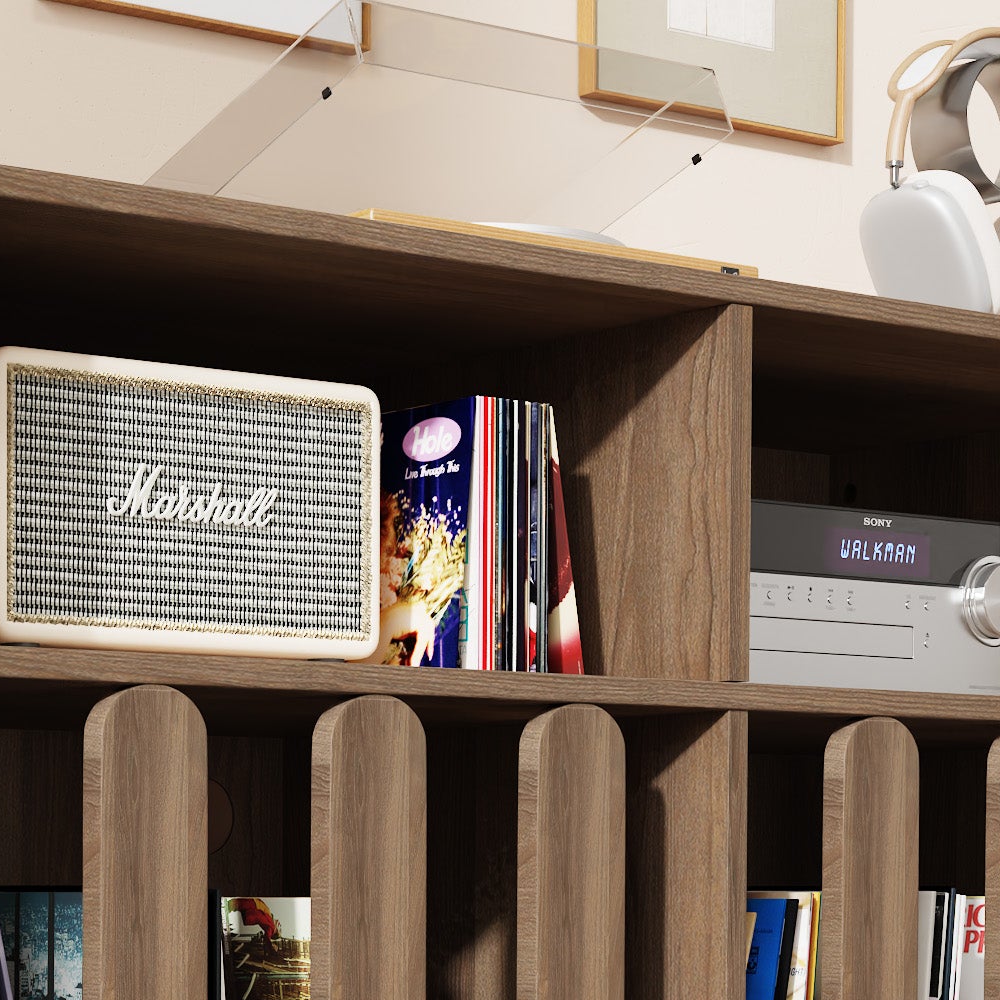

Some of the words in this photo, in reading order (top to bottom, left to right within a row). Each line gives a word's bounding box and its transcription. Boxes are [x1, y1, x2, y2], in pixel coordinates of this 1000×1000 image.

[411, 426, 454, 457] Hole
[405, 467, 419, 480] Live
[420, 463, 445, 478] Through
[446, 459, 461, 473] This
[106, 462, 279, 529] Marshall
[863, 517, 893, 528] SONY
[840, 538, 916, 565] WALKMAN
